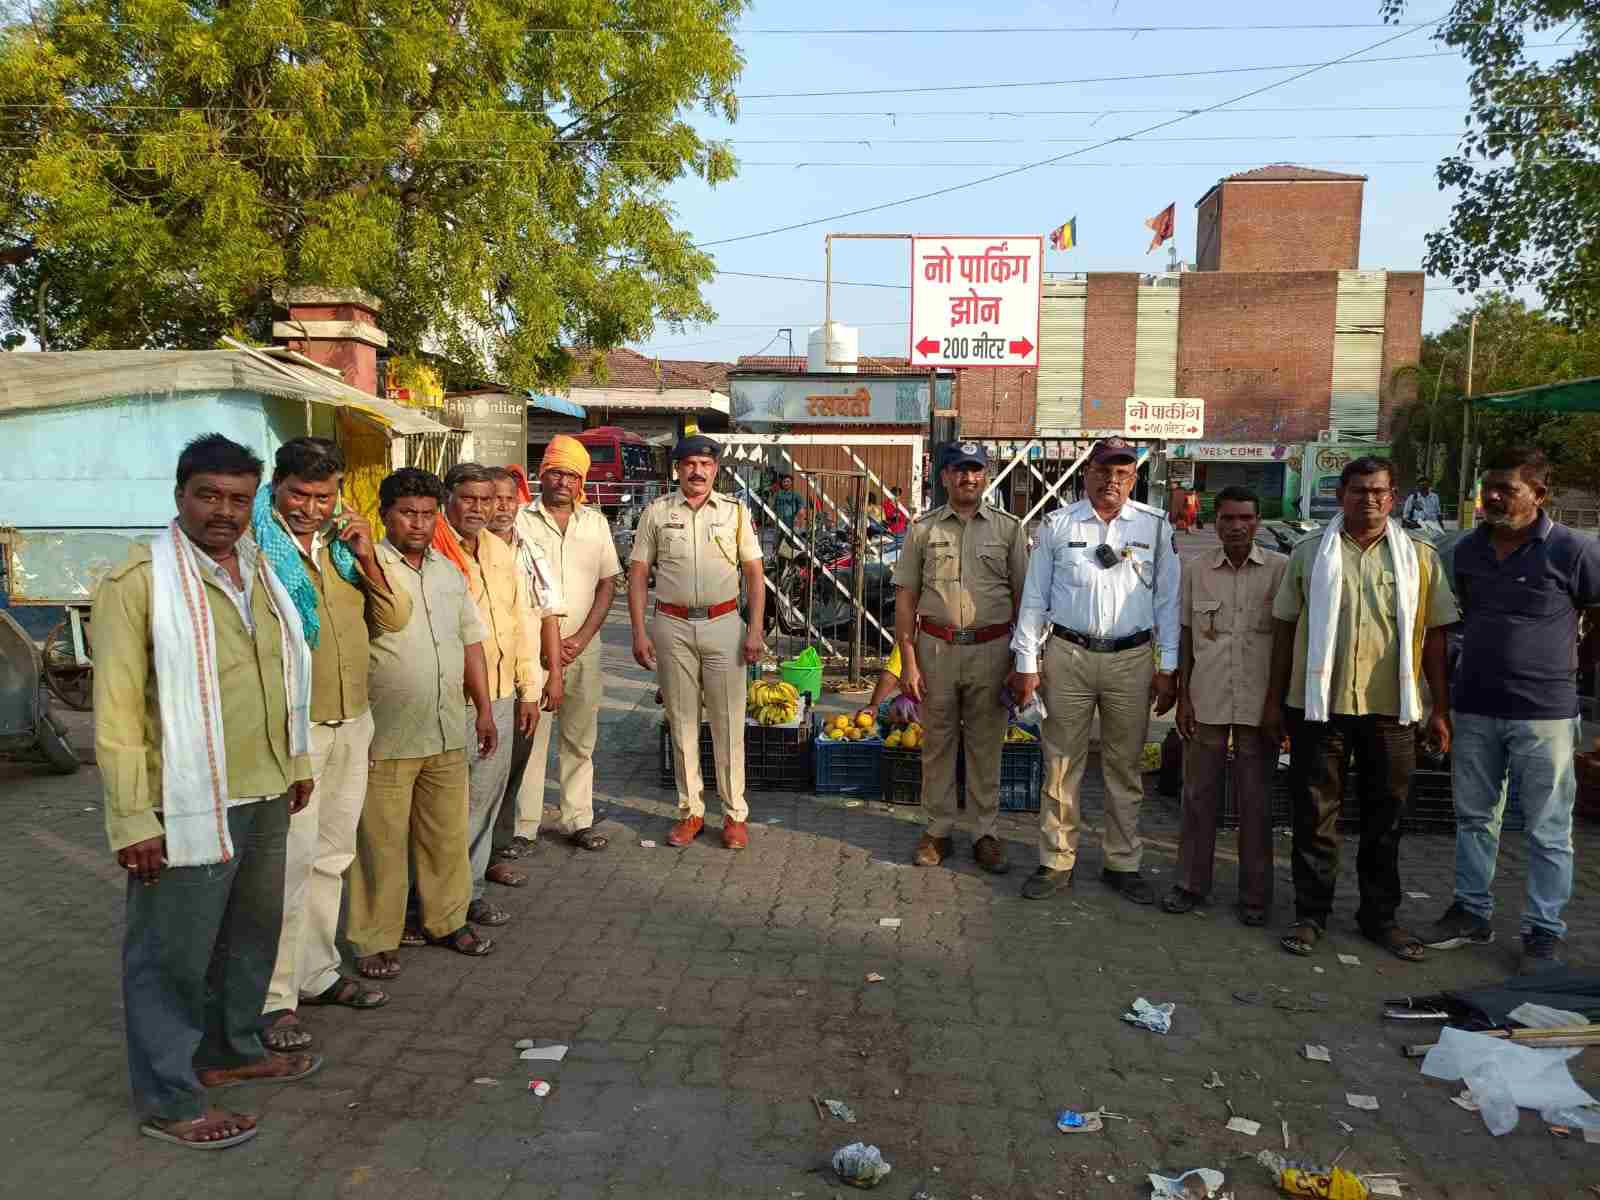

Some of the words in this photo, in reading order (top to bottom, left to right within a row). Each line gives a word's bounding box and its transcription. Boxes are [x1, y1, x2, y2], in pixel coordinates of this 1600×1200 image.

[923, 245, 954, 284] नो
[958, 241, 1031, 284] पार्किंग
[949, 287, 1003, 328] झोन
[943, 336, 969, 360] 200
[971, 331, 1006, 360] मीटर
[1127, 401, 1149, 420] नो
